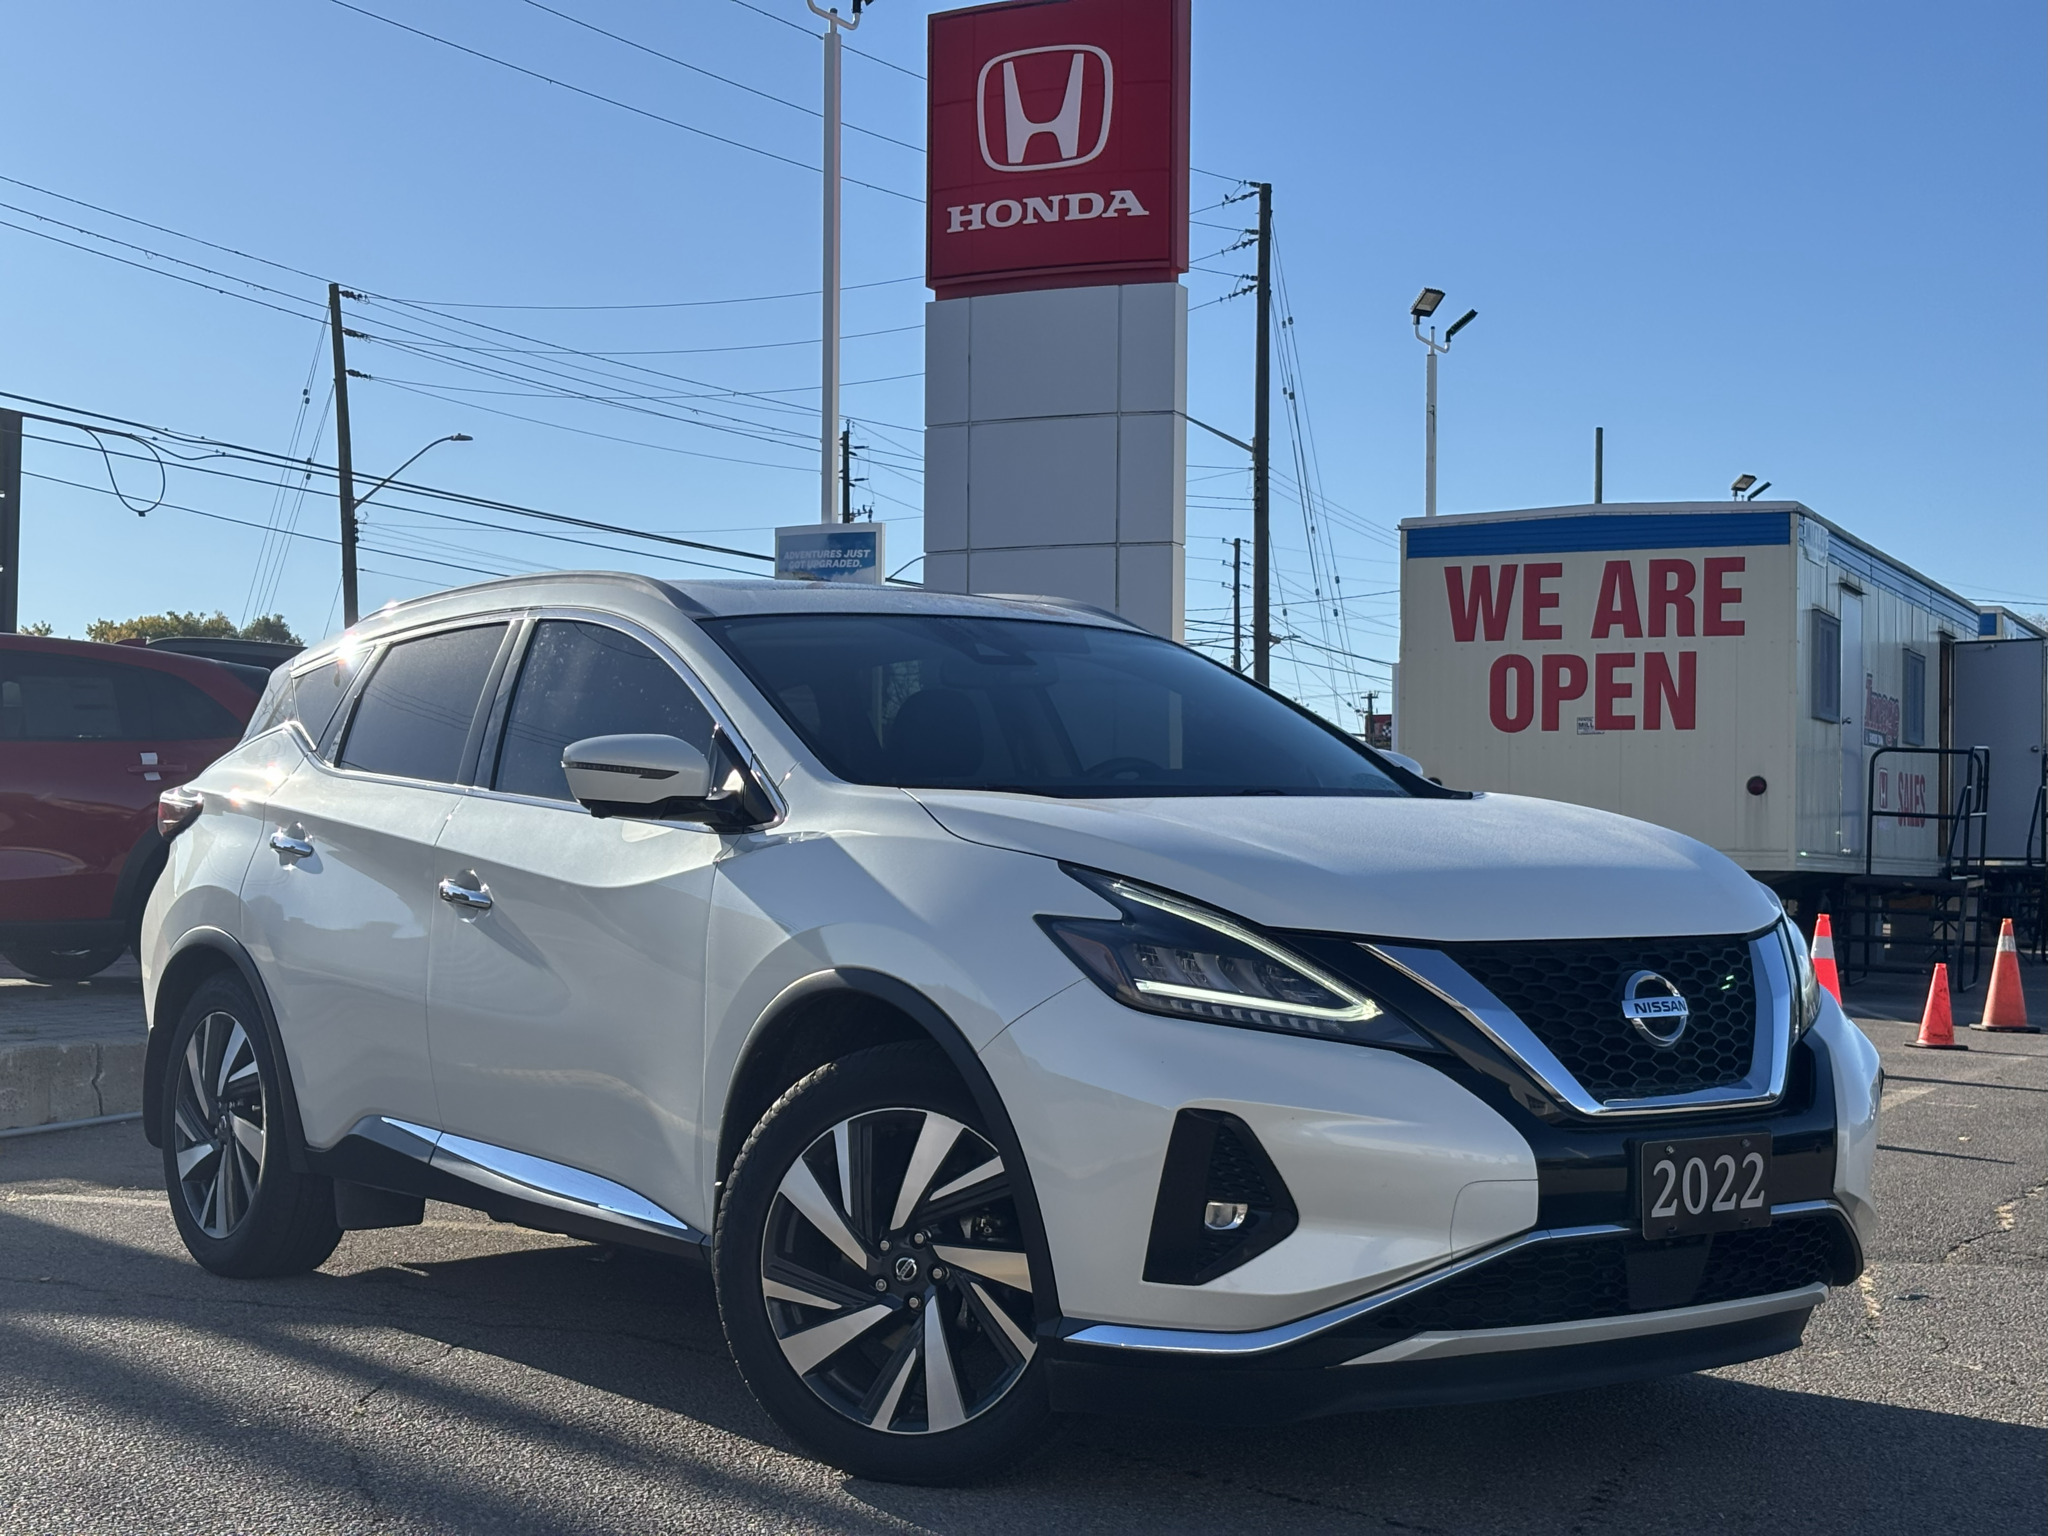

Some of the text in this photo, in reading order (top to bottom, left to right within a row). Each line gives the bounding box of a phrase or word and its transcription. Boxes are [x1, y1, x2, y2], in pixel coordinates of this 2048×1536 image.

[947, 190, 1149, 233] HONDA
[783, 549, 871, 560] ADVENTURES JUST
[788, 559, 863, 570] GOT UPGRADED.
[1444, 557, 1746, 642] WE ARE
[1489, 651, 1697, 733] OPEN
[1898, 772, 1926, 828] SALES
[1633, 1000, 1687, 1014] NISSAN
[1651, 1152, 1765, 1218] 2022
